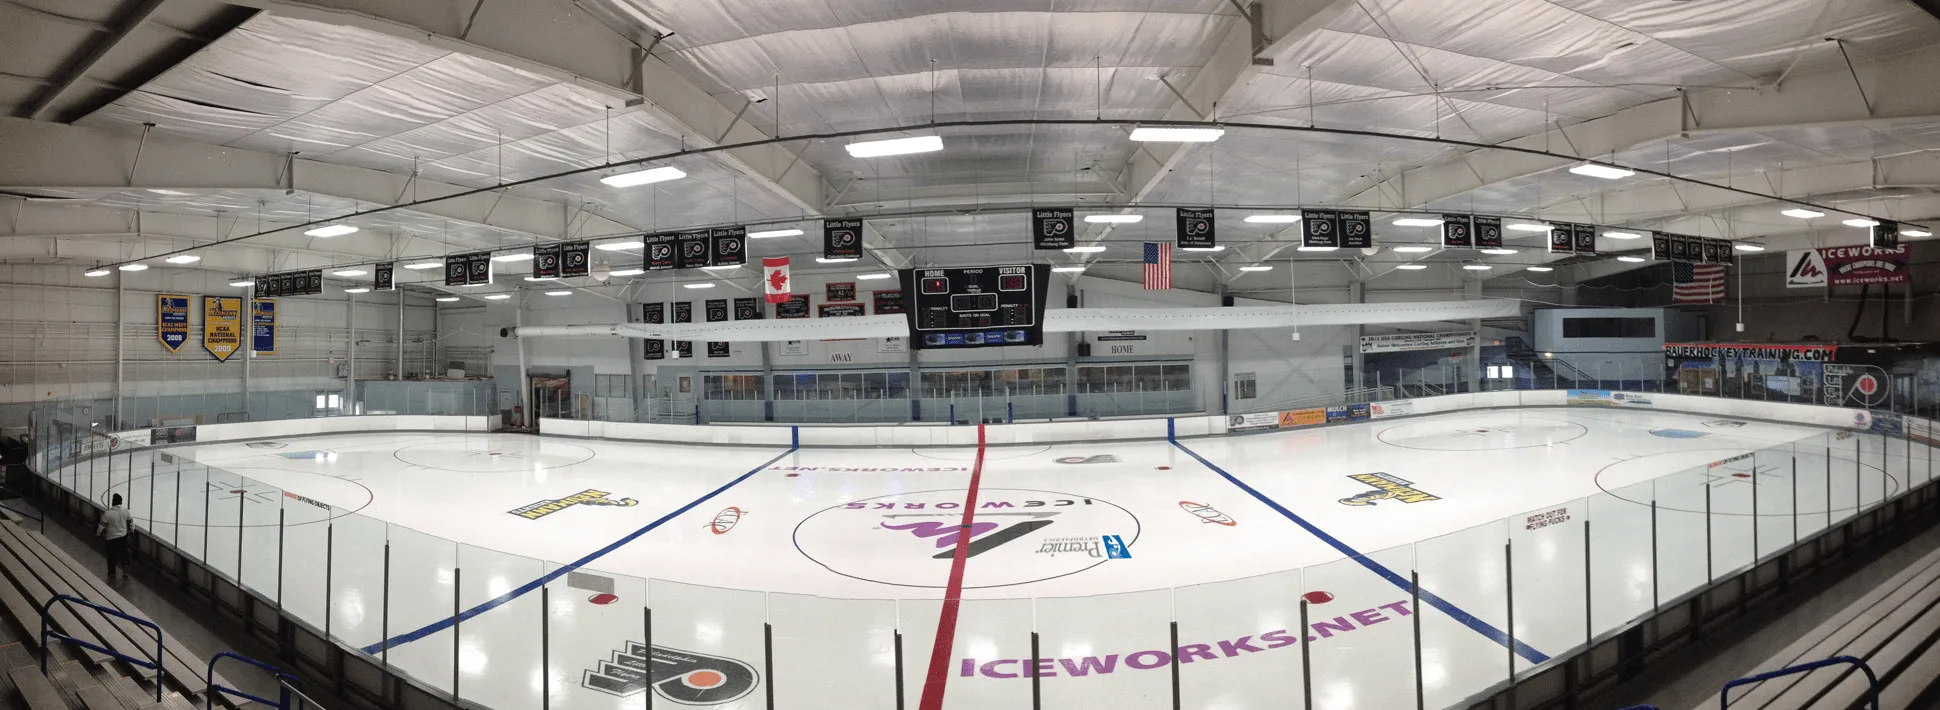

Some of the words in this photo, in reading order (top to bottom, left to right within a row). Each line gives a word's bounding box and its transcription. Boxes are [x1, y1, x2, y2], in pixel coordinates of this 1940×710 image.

[1822, 244, 1905, 259] ICEWOS
[999, 266, 1026, 274] VISITOR
[1111, 344, 1135, 354] HOME
[831, 353, 852, 362] AWAY
[1040, 541, 1103, 558] Premier
[960, 600, 1413, 679] ICEWORKS.NET
